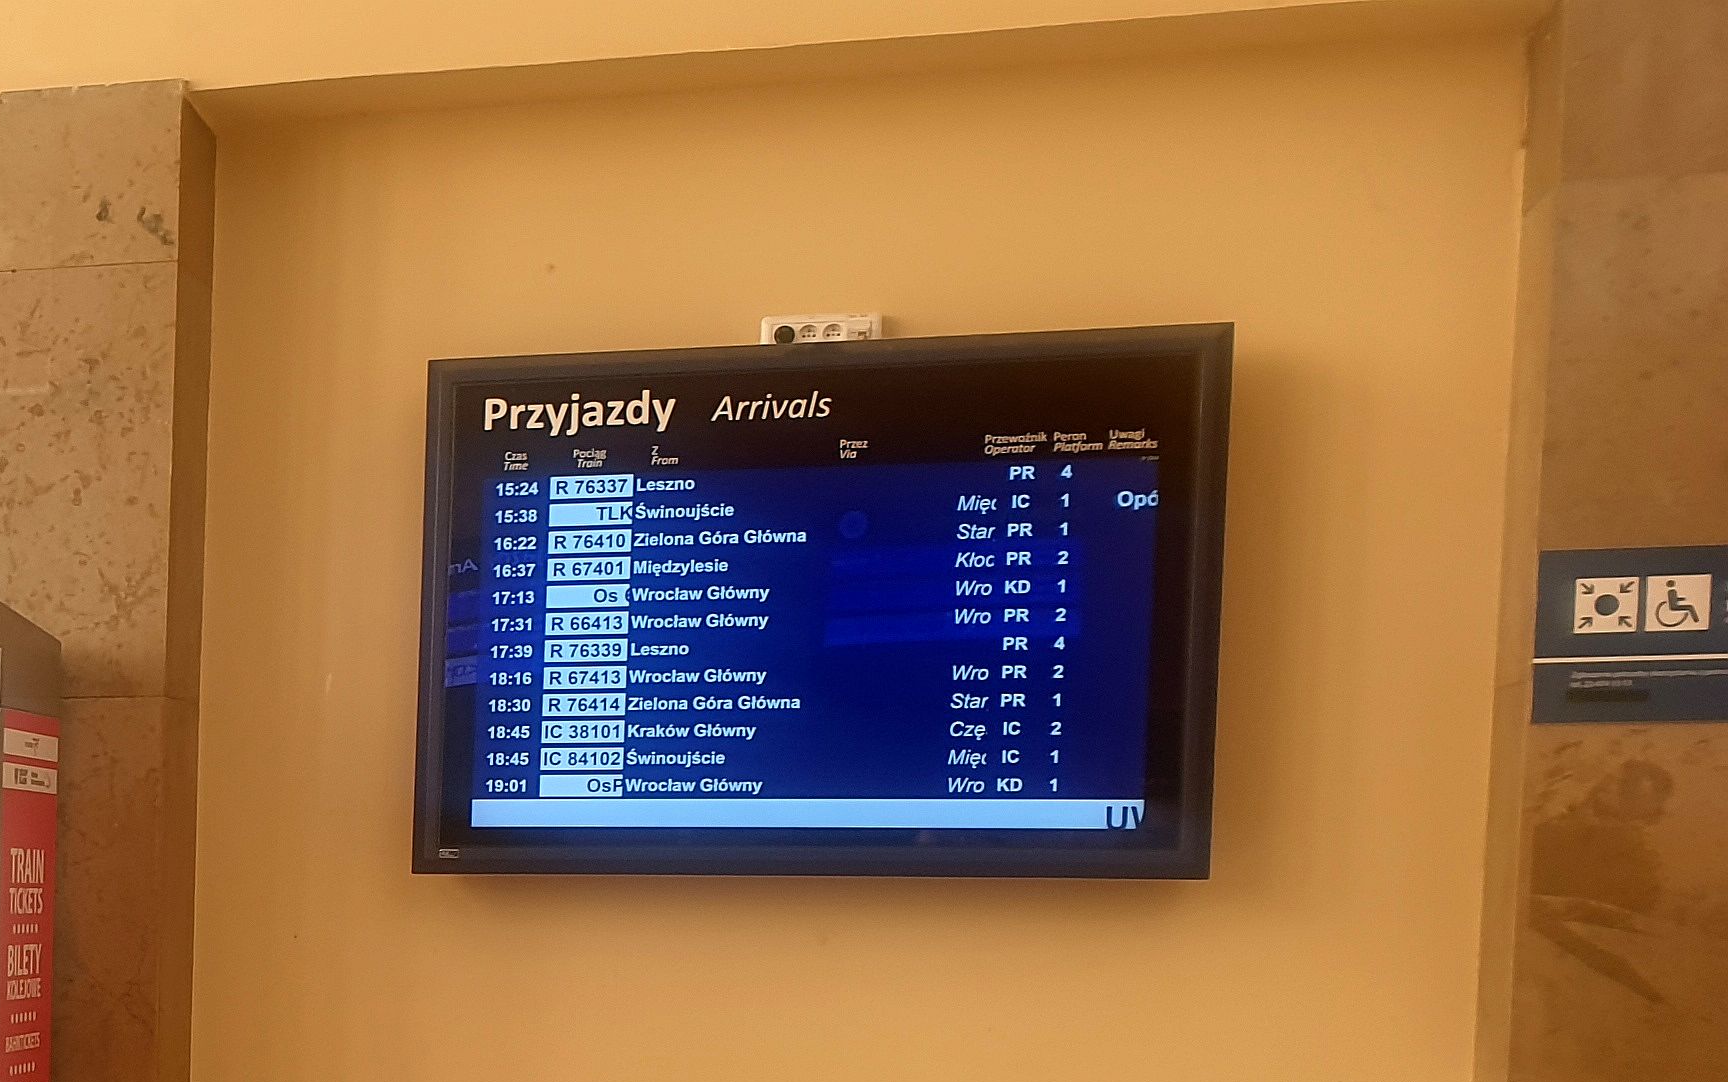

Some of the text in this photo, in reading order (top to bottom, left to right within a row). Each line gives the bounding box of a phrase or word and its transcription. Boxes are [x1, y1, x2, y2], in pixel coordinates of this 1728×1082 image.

[484, 389, 832, 436] Przyjazdy Arrivals
[496, 466, 1035, 496] 15:24 76337 Leszno PR
[495, 495, 1030, 524] 15:38 TLK Świnoujście IC
[494, 523, 1033, 550] 16:22 76410 Zielona Góra Główna PR
[493, 551, 1032, 578] 16:37 67401 Międzylesie PR
[492, 580, 1031, 605] 17:13 Wrocław Główny KD
[492, 613, 768, 632] 17:31 66413 Wrocław Główny
[491, 637, 1028, 659] 17:39 76339 Leszno PR
[490, 668, 766, 686] 18:16 67413 Wrocław Główny
[489, 694, 1026, 712] 18:30 76414 Zielona Góra Główna PR
[488, 722, 1021, 740] 18:45 38101 Kraków Główny IC
[487, 749, 1020, 767] 18:45 84102 Świnoujście IC
[486, 777, 1022, 795] 19:01 Wrocław Główny KD
[10, 848, 45, 884] TRAIN
[9, 886, 43, 914] TICKETS
[7, 944, 41, 977] BILETY
